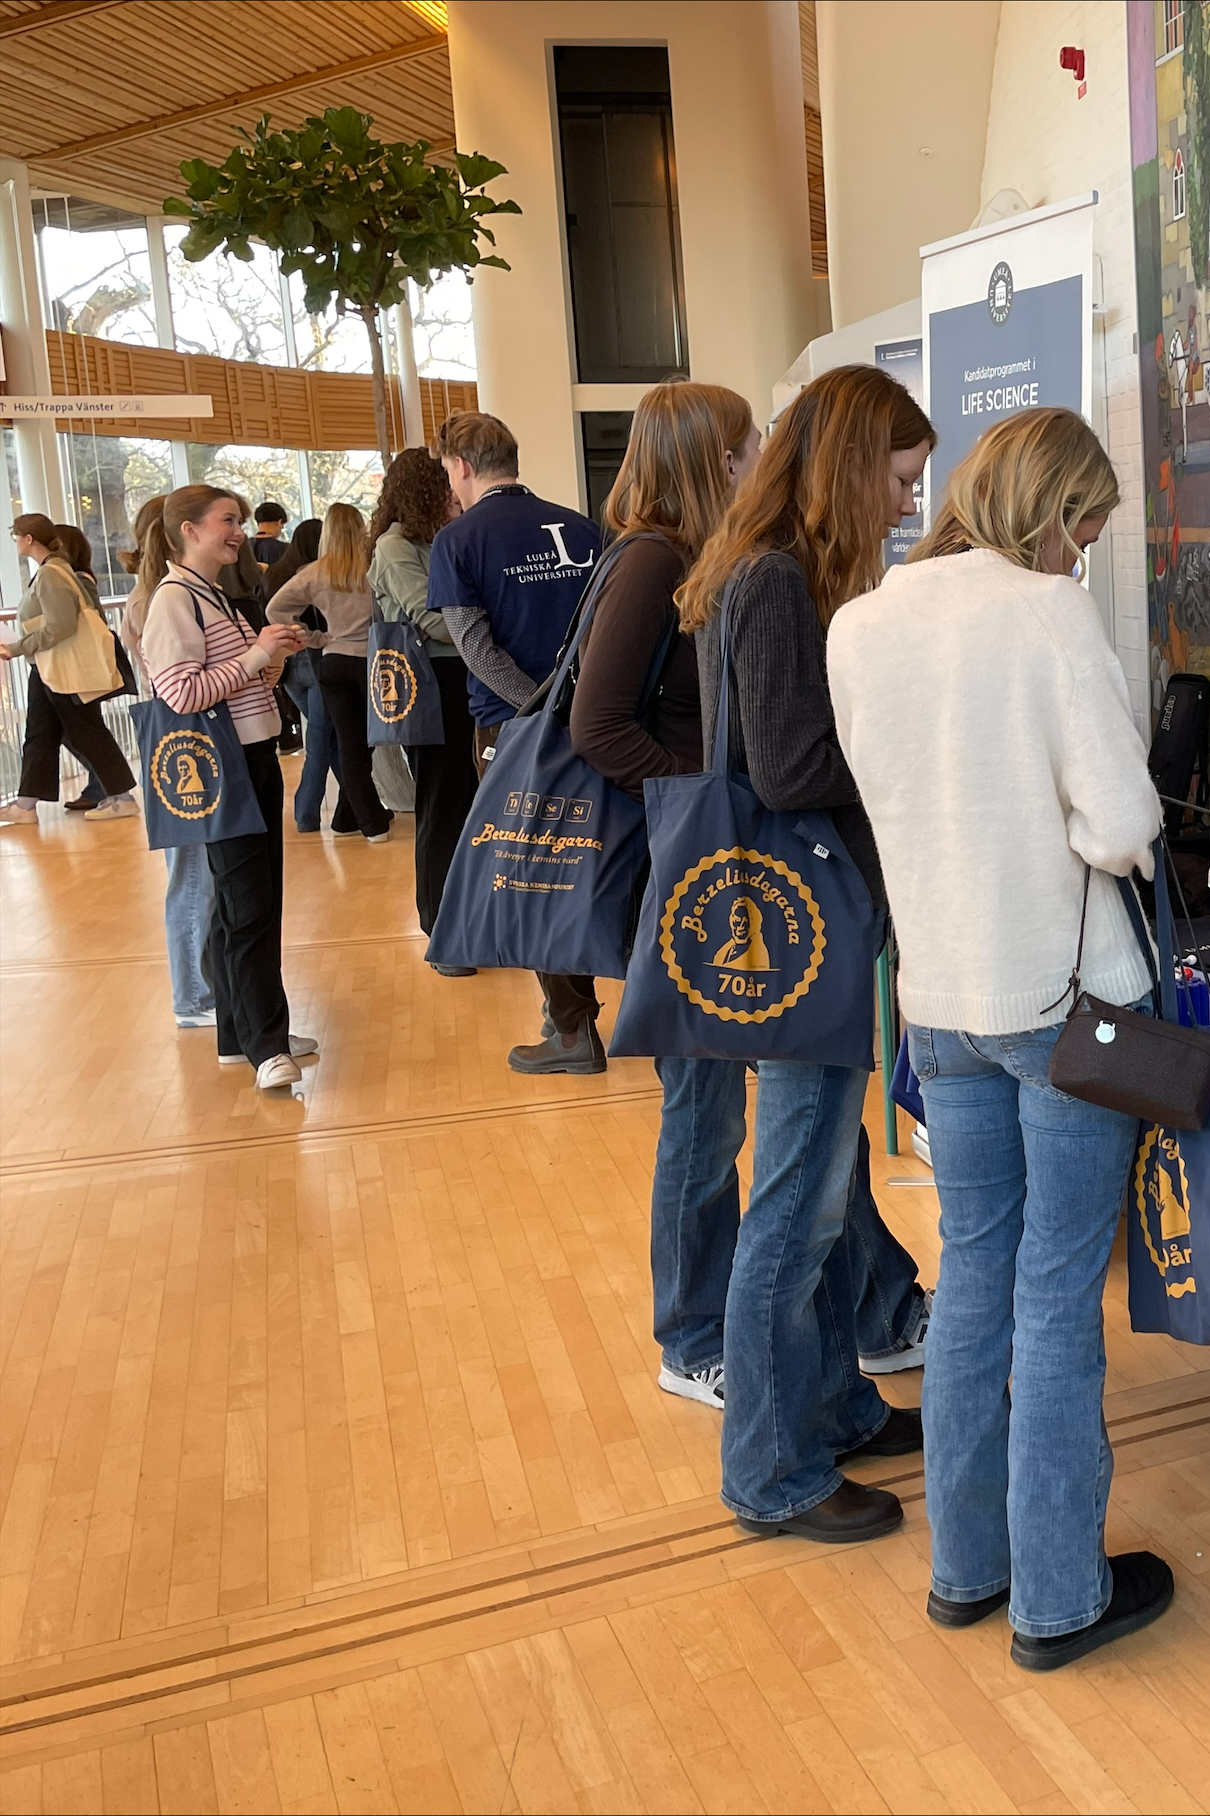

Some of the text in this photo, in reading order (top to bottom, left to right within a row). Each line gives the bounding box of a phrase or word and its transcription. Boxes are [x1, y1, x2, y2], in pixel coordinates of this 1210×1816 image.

[964, 356, 1037, 383] Kandidatprogrammet i
[961, 382, 1039, 416] LIFE SCIENCE
[13, 402, 114, 413] Hiss/Trappa Vänster
[526, 550, 557, 563] LULEÅ
[503, 562, 552, 576] TEKNISKA
[518, 568, 583, 584] UNIVERSITET
[180, 793, 204, 807] 70år
[681, 866, 800, 945] Berzeliusdagarna
[717, 972, 767, 998] 70år
